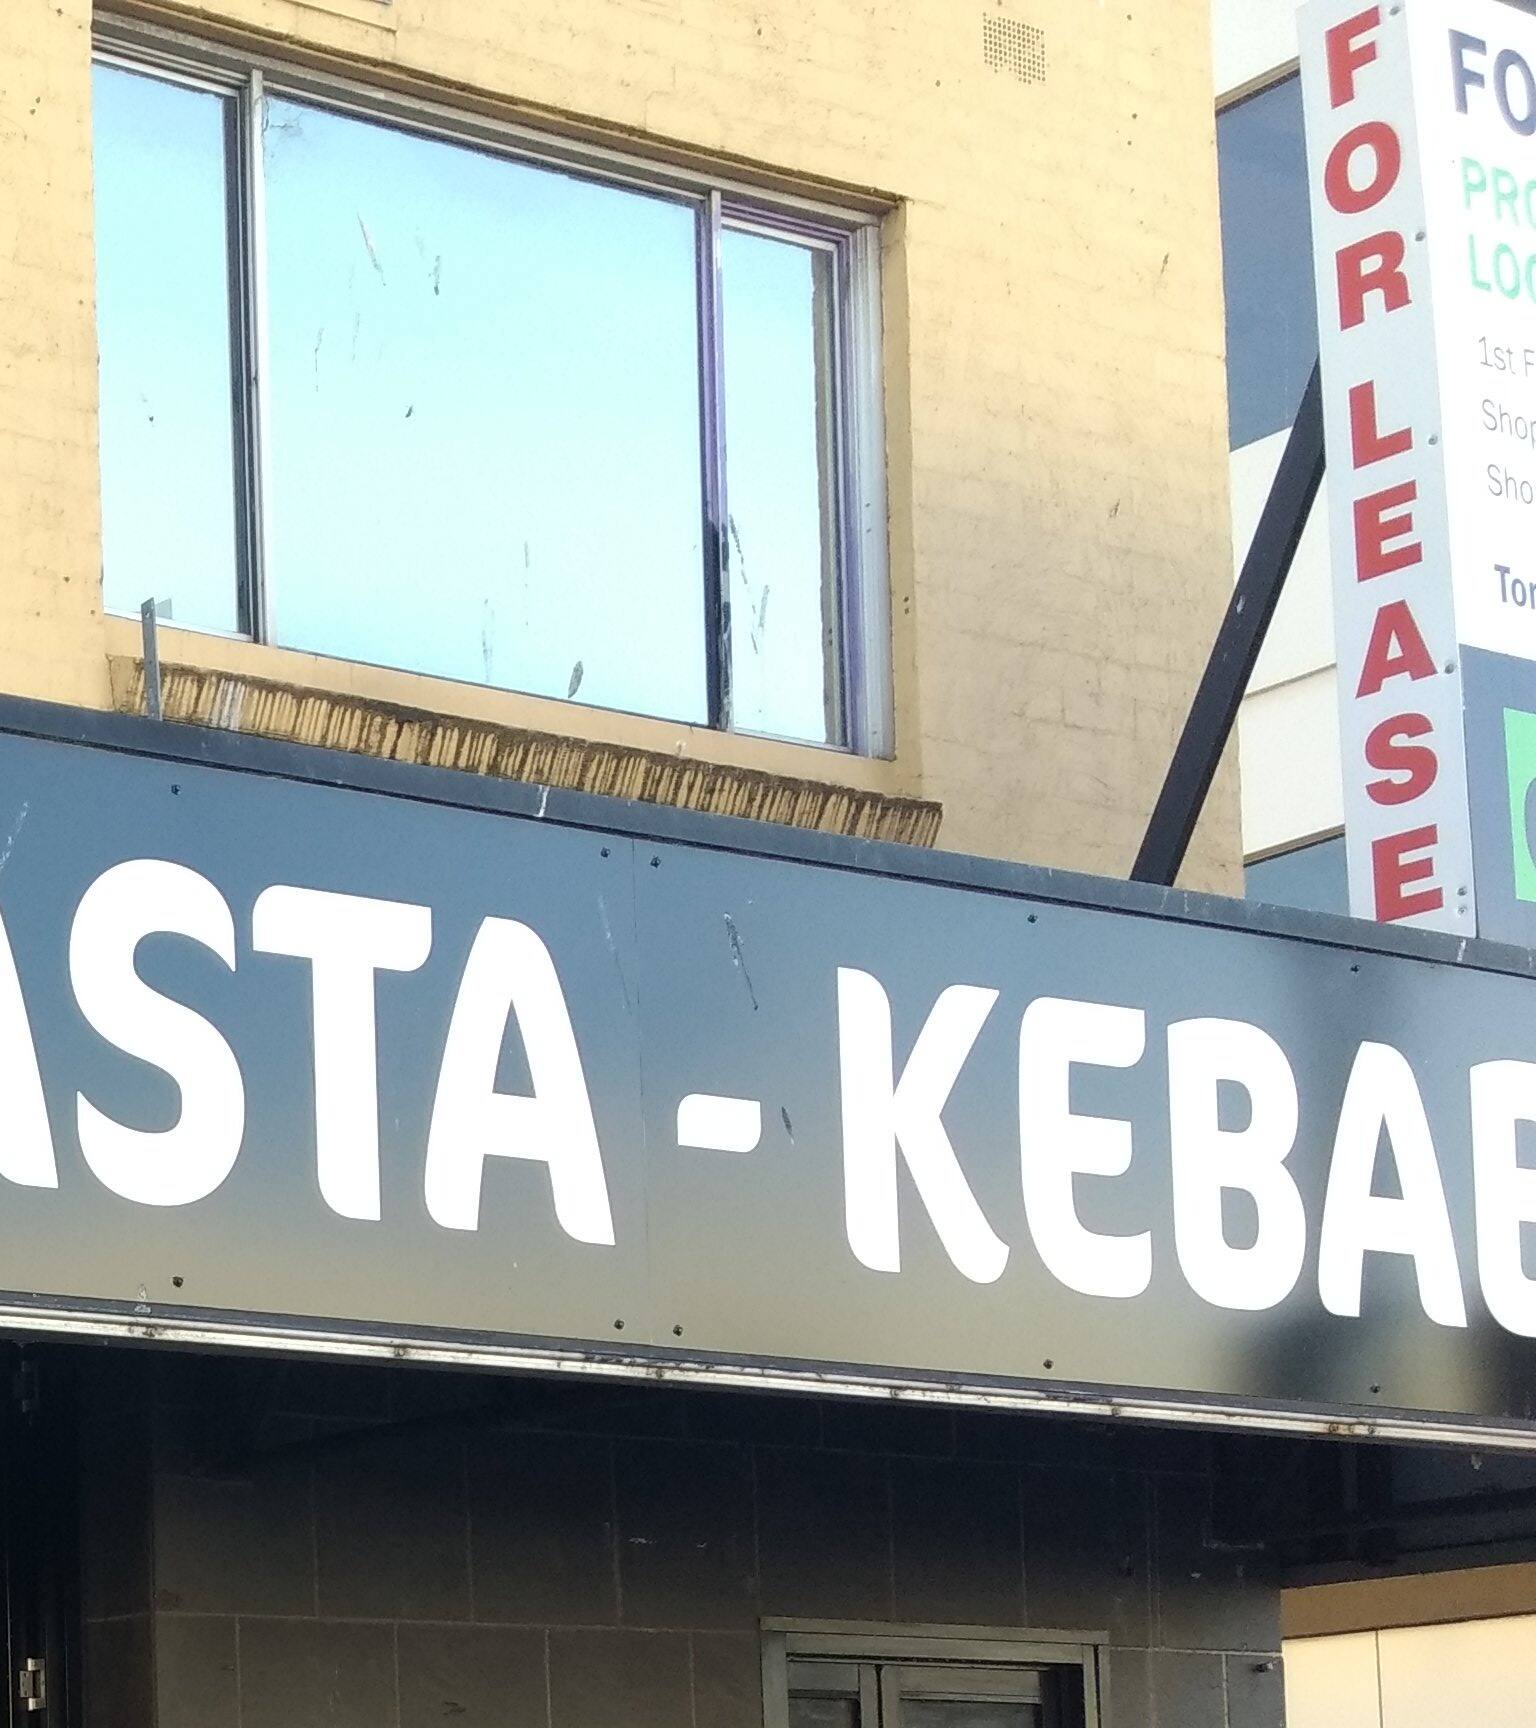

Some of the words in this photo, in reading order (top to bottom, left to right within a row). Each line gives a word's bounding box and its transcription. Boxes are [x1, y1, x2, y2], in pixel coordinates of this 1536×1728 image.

[1323, 4, 1412, 333] FOR
[1478, 336, 1516, 375] 1st
[1349, 381, 1443, 925] LEASE
